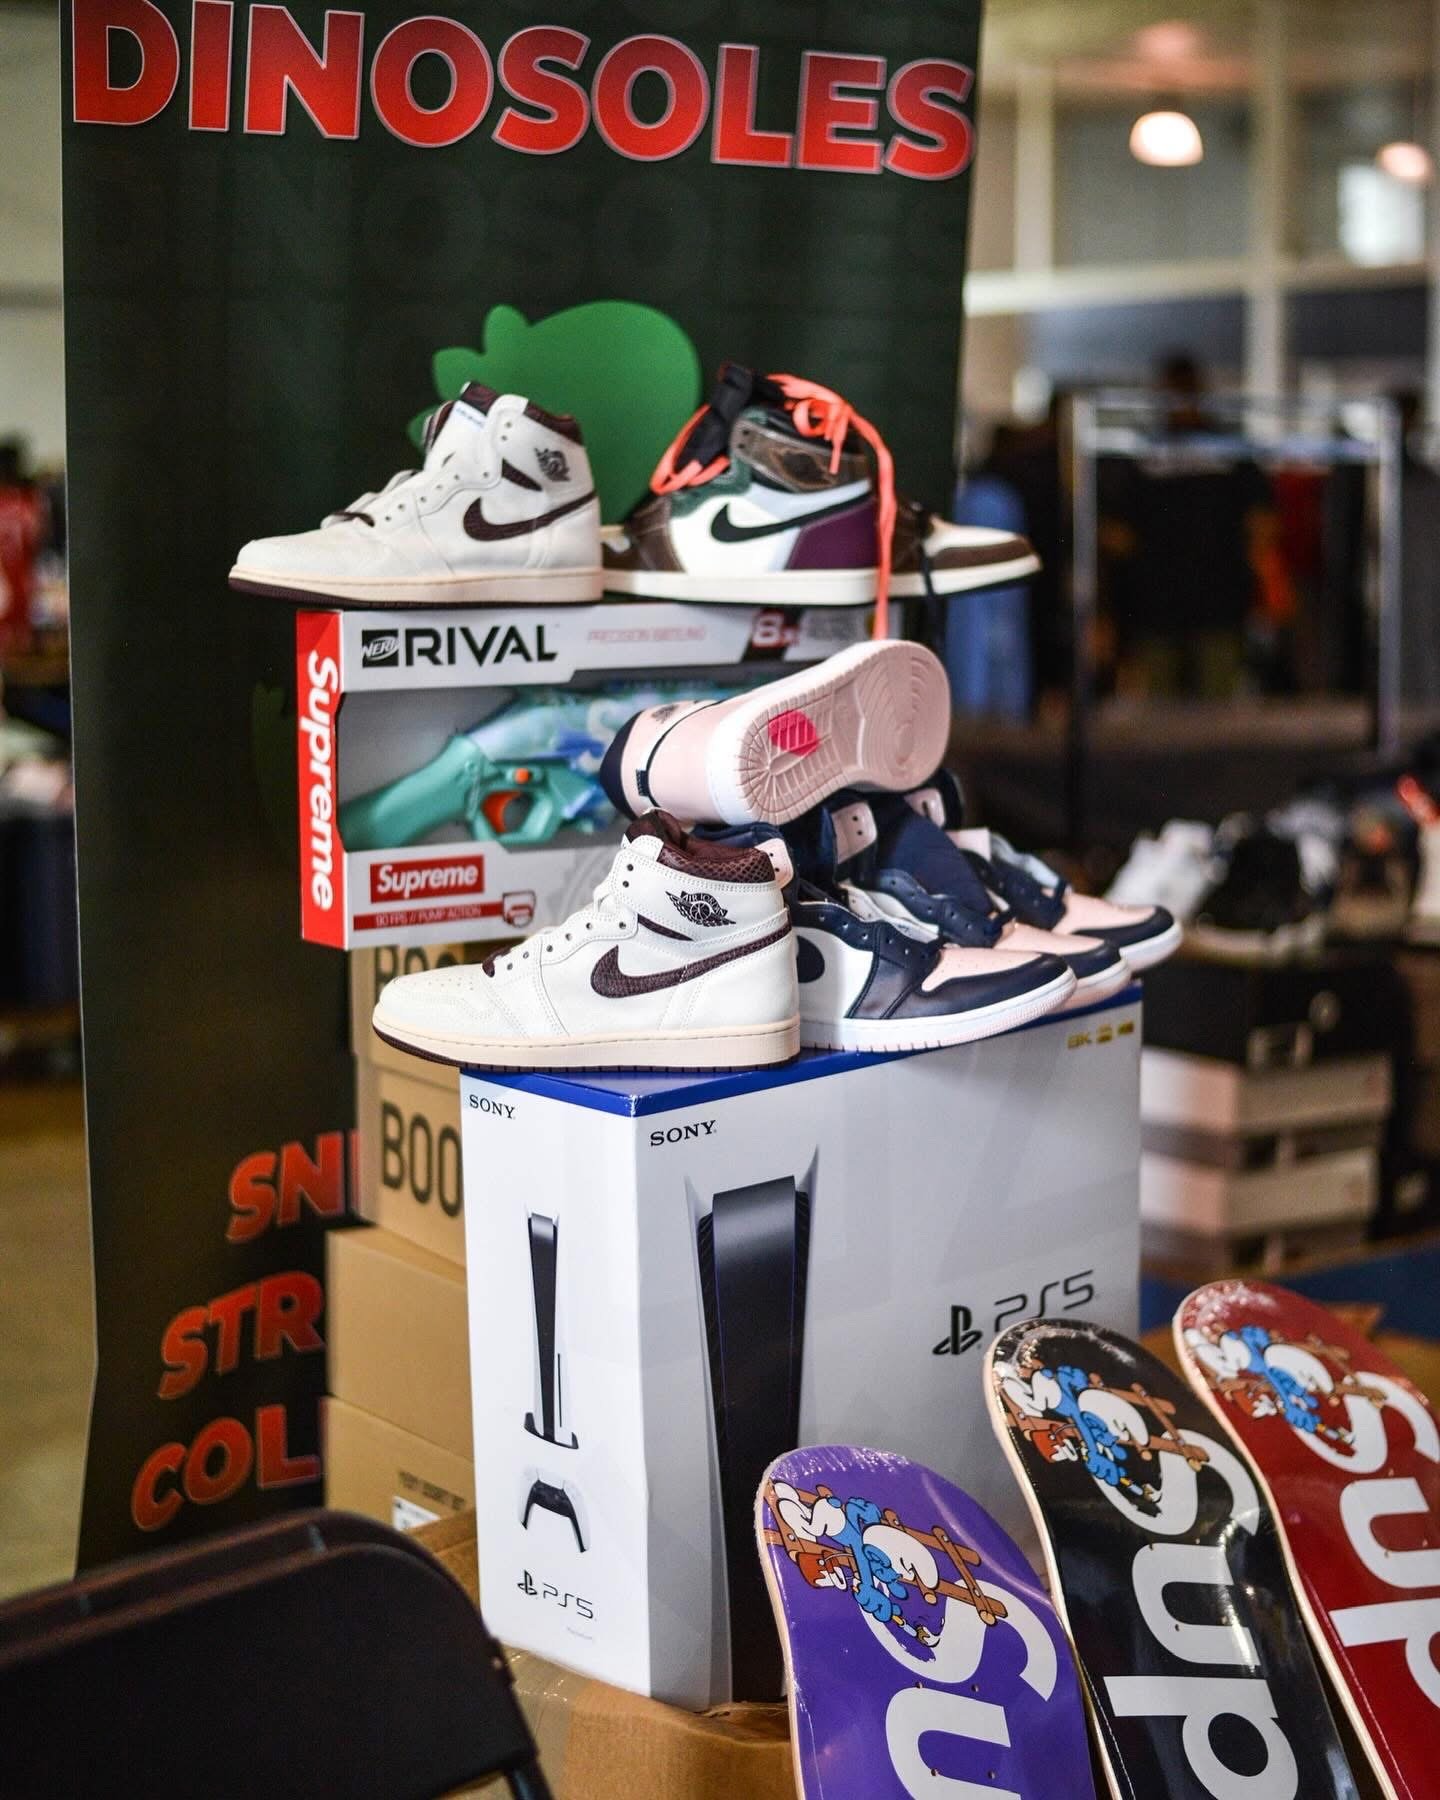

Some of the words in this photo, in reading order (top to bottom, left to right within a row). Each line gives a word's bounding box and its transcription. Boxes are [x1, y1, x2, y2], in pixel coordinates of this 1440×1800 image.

[72, 0, 976, 181] DINOSOLES
[404, 625, 558, 667] RIVAL
[300, 650, 339, 911] Supreme
[377, 864, 479, 899] Supreme
[468, 1094, 515, 1119] SONY
[650, 1120, 717, 1146] SONY
[994, 1269, 1095, 1333] PS5
[132, 1397, 327, 1532] COL
[543, 1582, 594, 1619] PS5
[1092, 1428, 1299, 1800] Sup
